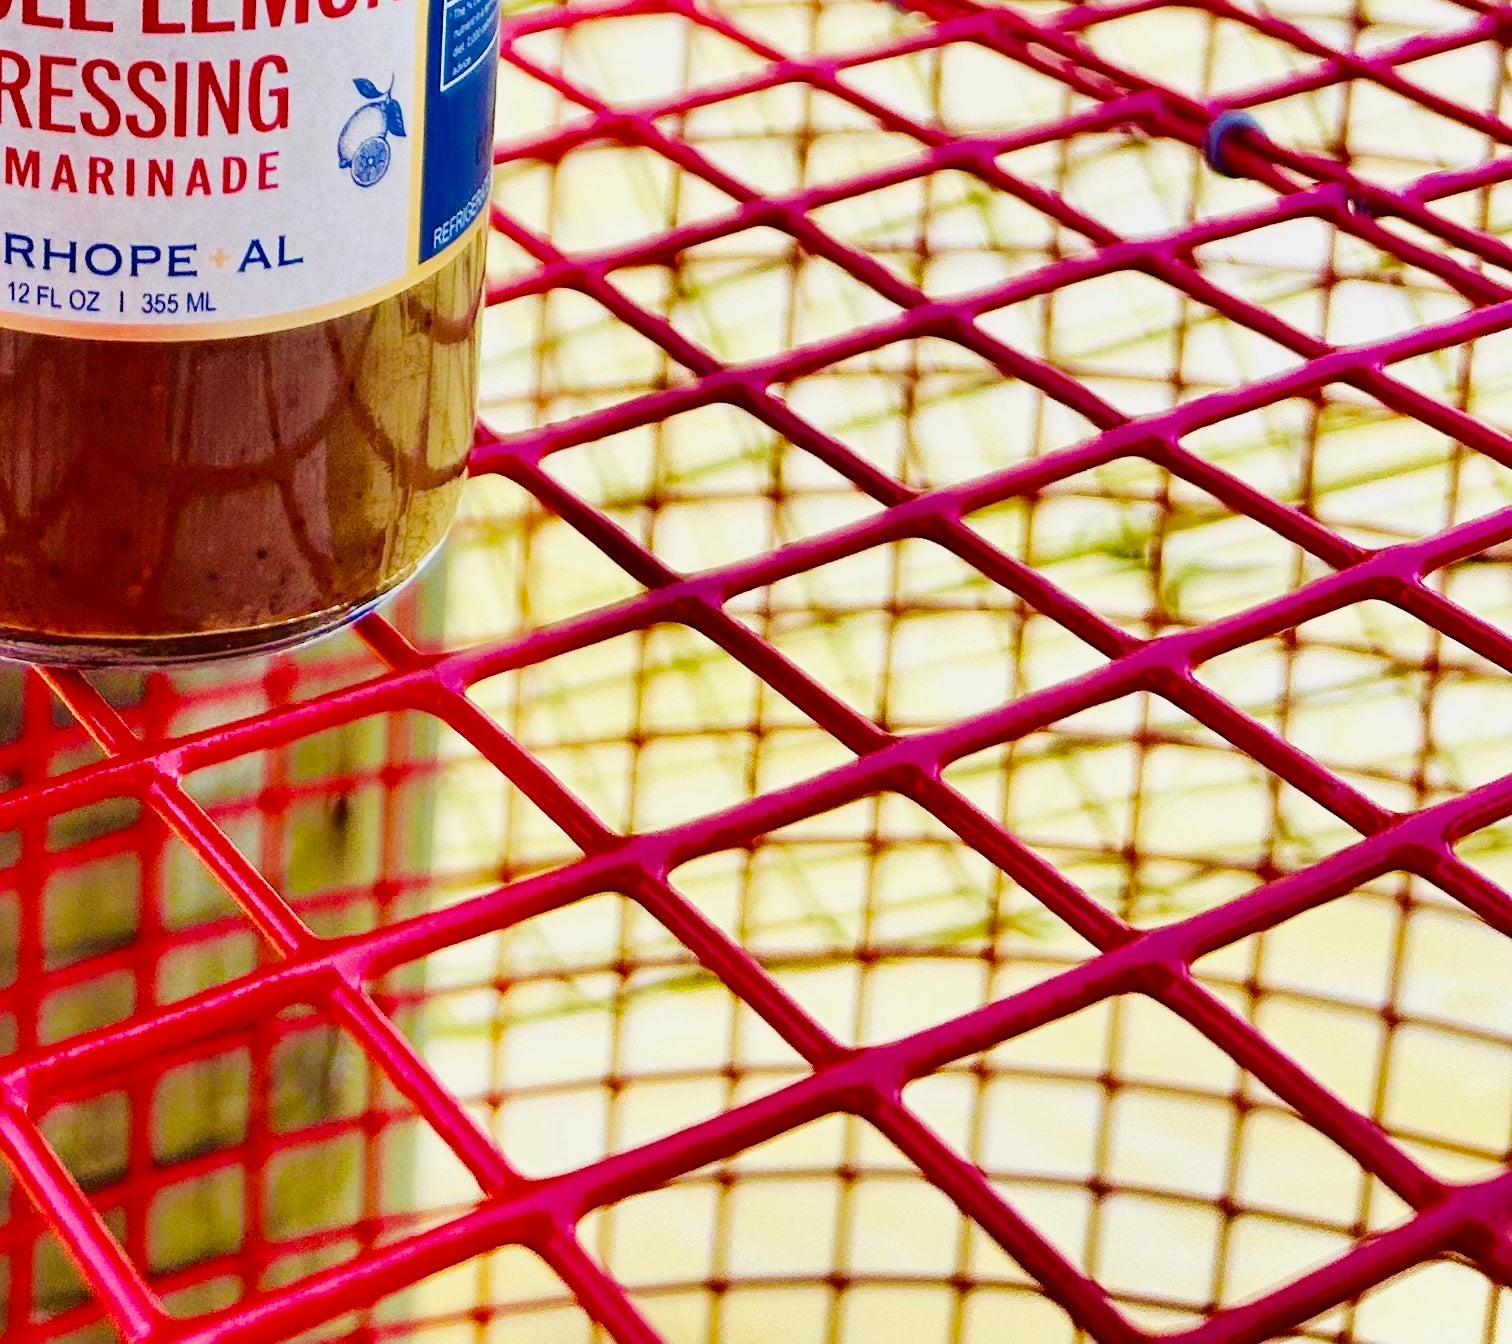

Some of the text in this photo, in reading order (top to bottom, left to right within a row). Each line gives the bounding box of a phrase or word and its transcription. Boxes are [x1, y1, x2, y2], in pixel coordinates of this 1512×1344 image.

[4, 146, 280, 197] MARINADE
[237, 235, 304, 273] AL
[8, 281, 30, 304] 12
[37, 285, 61, 309] FL
[69, 289, 100, 311] OZ
[142, 293, 178, 314] 355
[187, 291, 216, 312] ML
